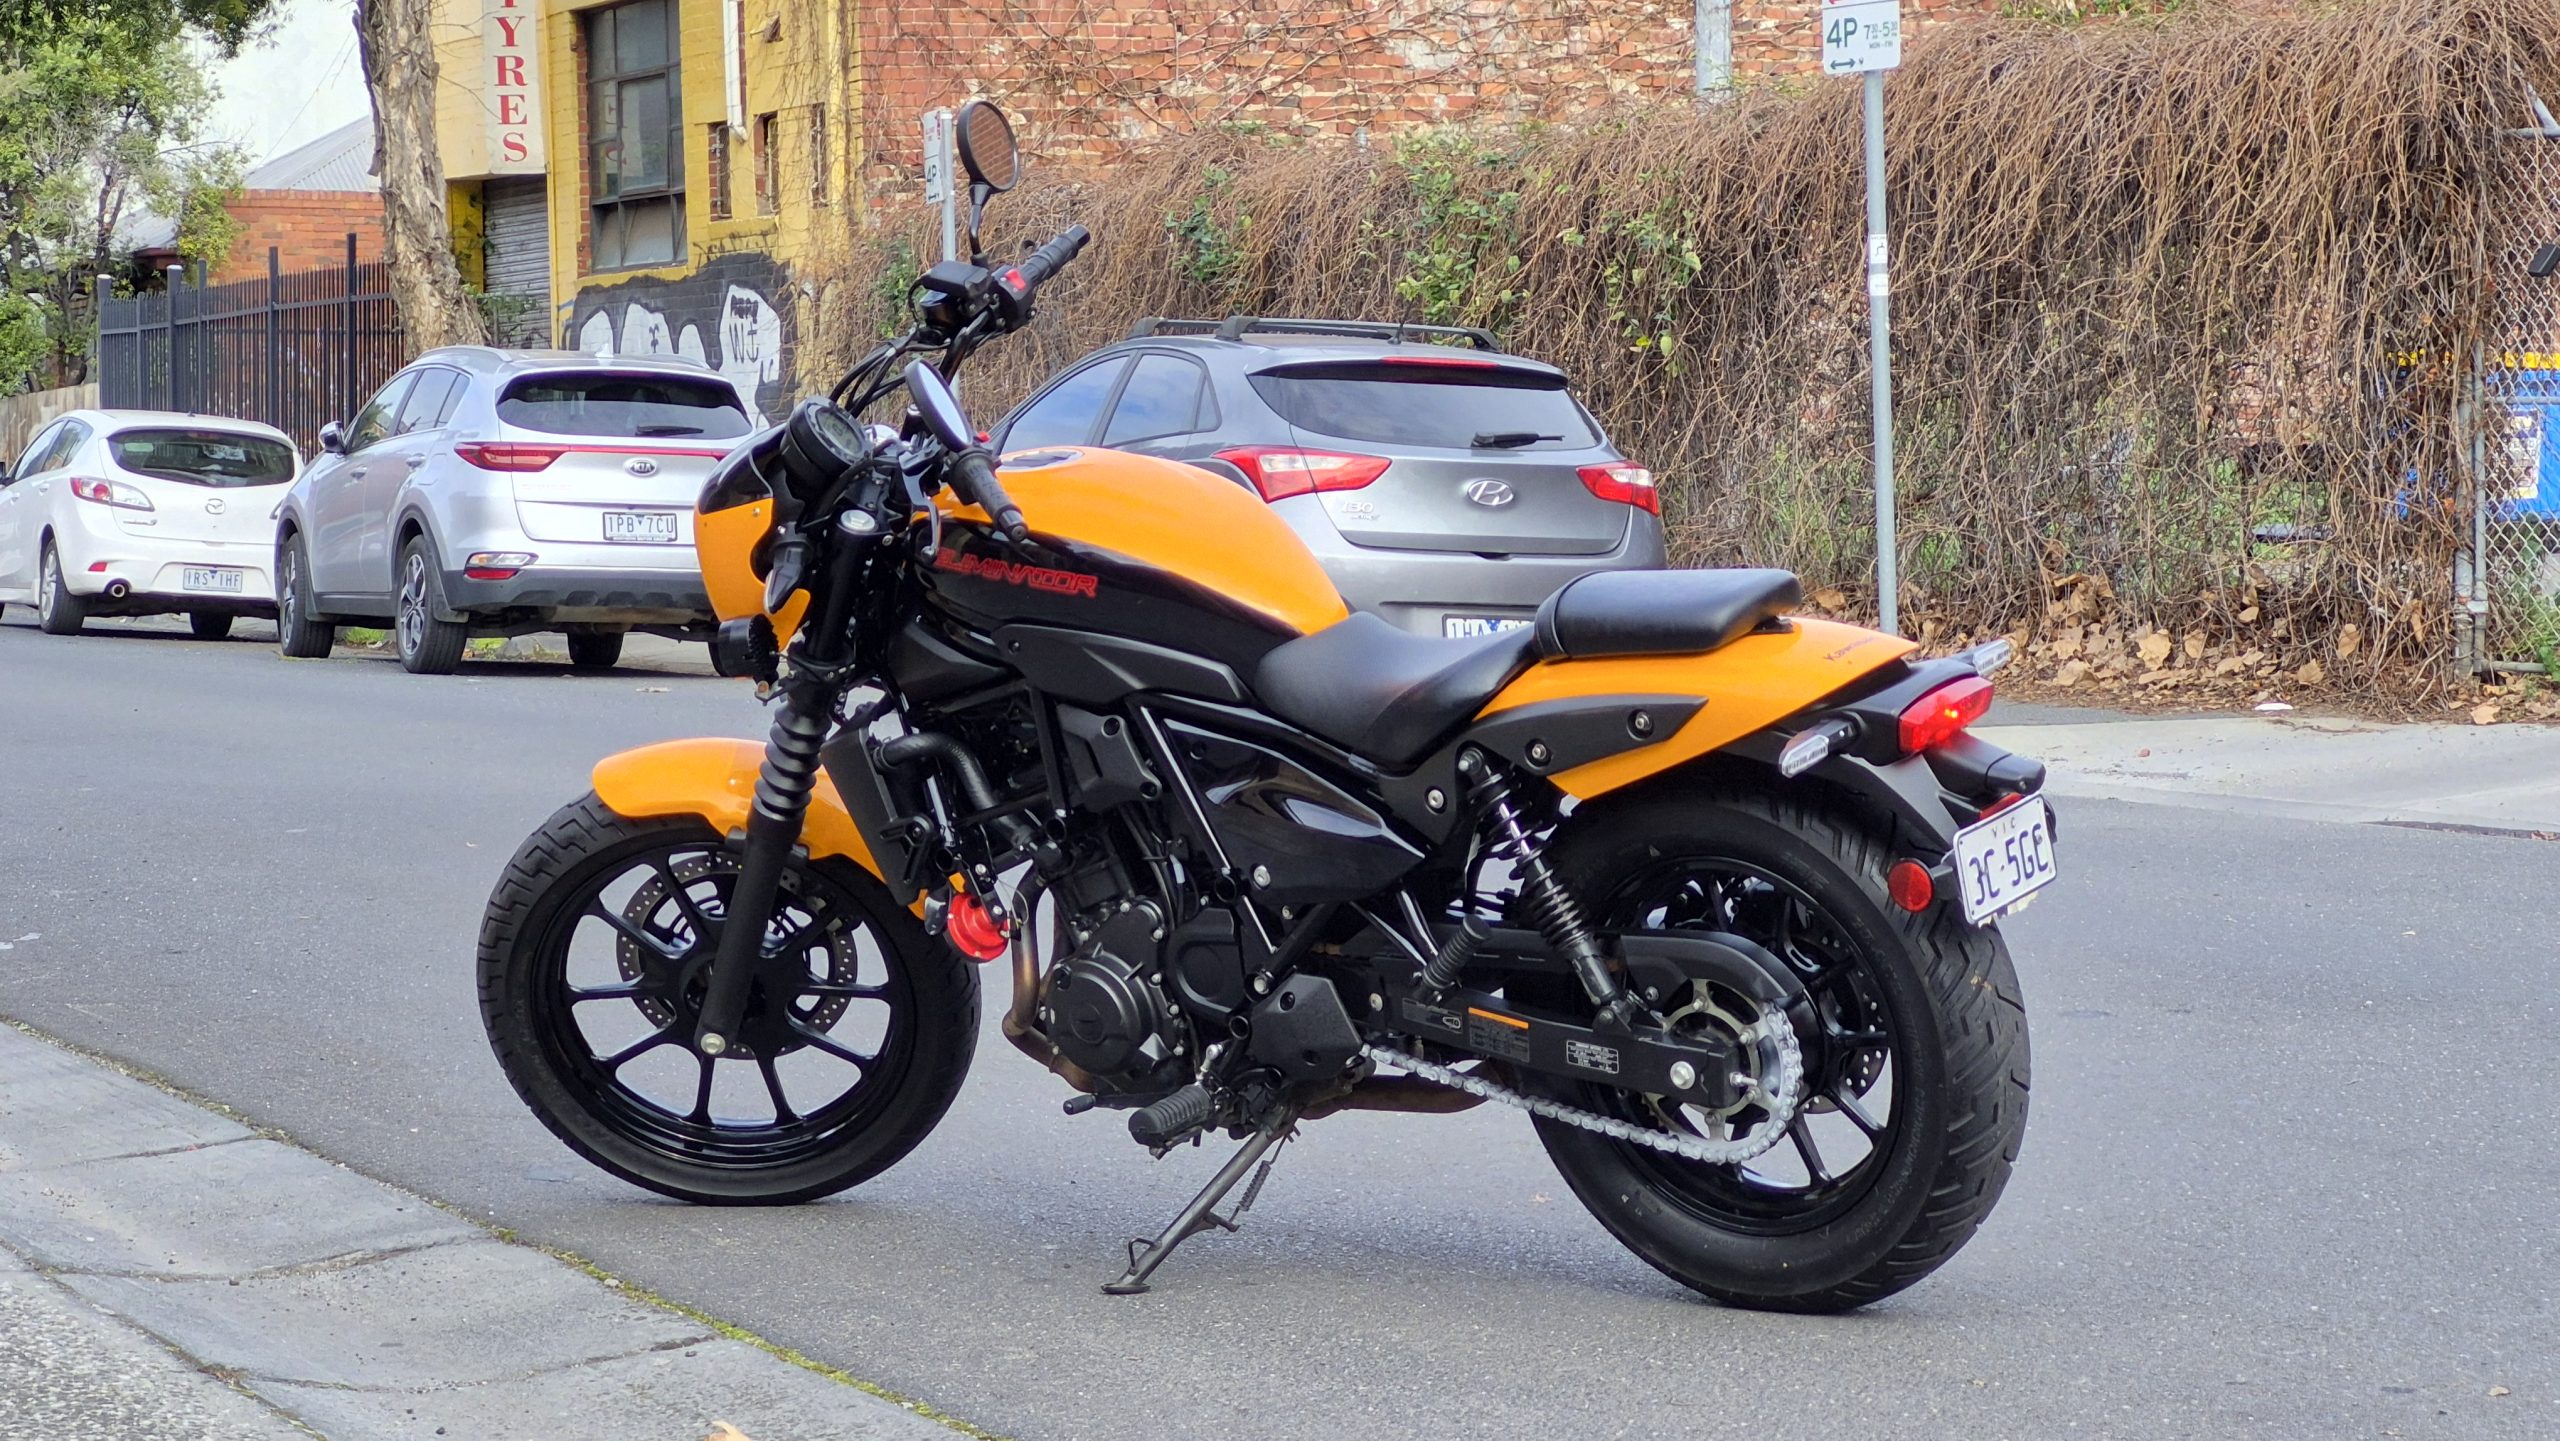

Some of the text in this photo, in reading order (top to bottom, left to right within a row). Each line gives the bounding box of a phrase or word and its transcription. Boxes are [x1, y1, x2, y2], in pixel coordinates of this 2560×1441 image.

[1826, 17, 1858, 49] 4P
[633, 462, 652, 472] KIA
[1992, 817, 2016, 838] VIC
